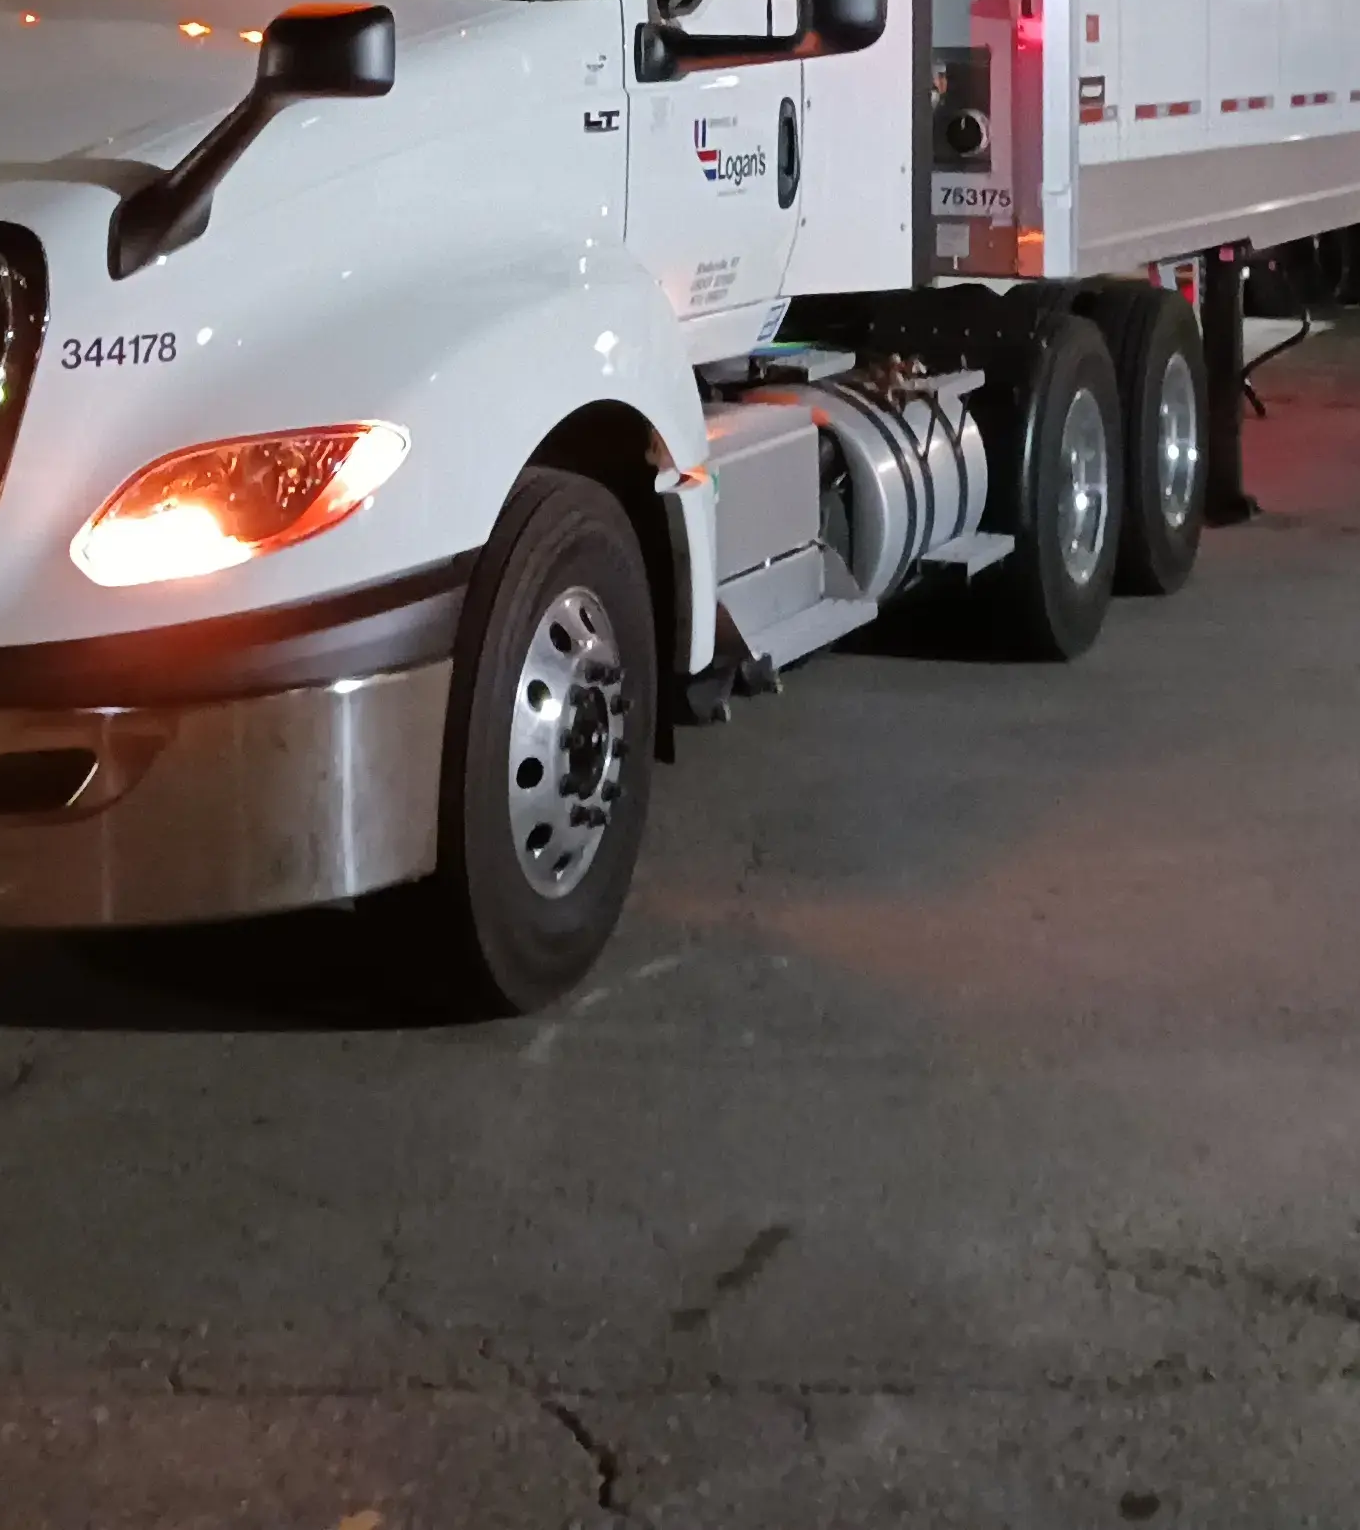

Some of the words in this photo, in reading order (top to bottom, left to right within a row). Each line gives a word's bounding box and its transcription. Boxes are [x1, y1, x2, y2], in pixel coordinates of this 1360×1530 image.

[584, 110, 620, 131] LT
[718, 145, 766, 186] Logan's
[941, 186, 1011, 207] 763175
[61, 332, 176, 369] 344178
